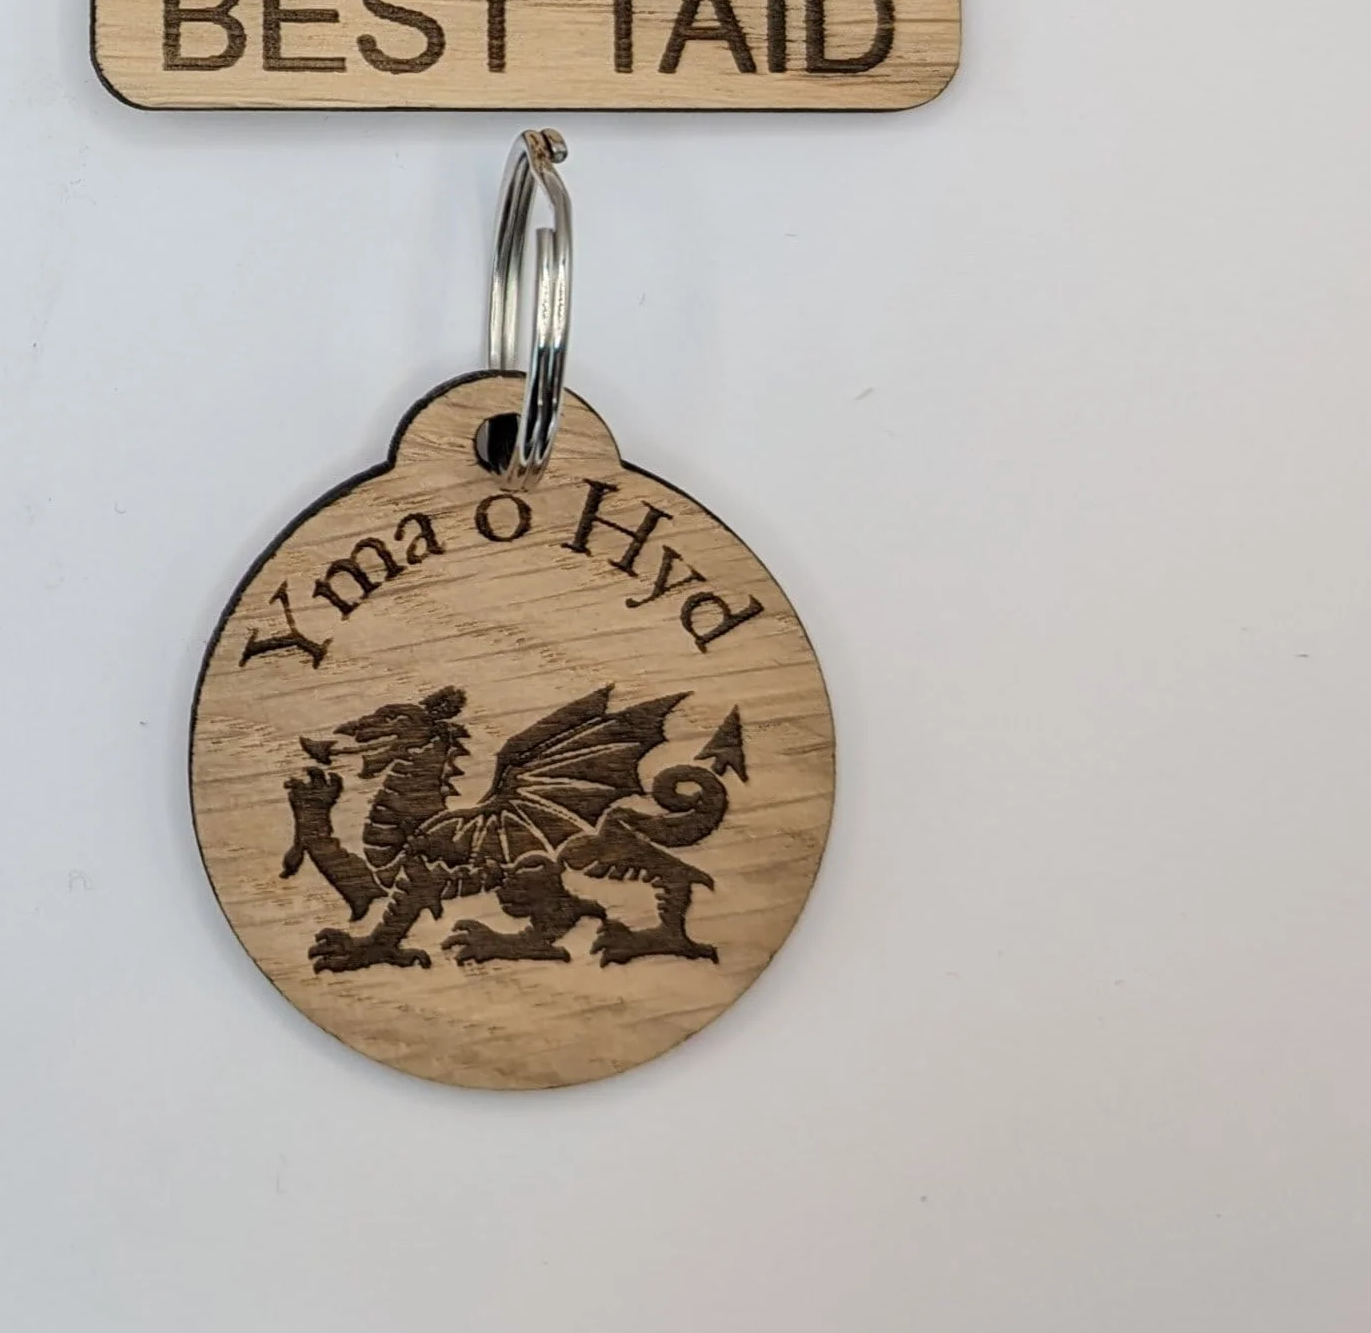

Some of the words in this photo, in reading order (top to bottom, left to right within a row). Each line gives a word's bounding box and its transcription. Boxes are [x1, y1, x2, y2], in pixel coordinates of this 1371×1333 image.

[238, 511, 446, 669] Yma
[473, 492, 533, 543] o
[561, 478, 765, 654] Hyd
